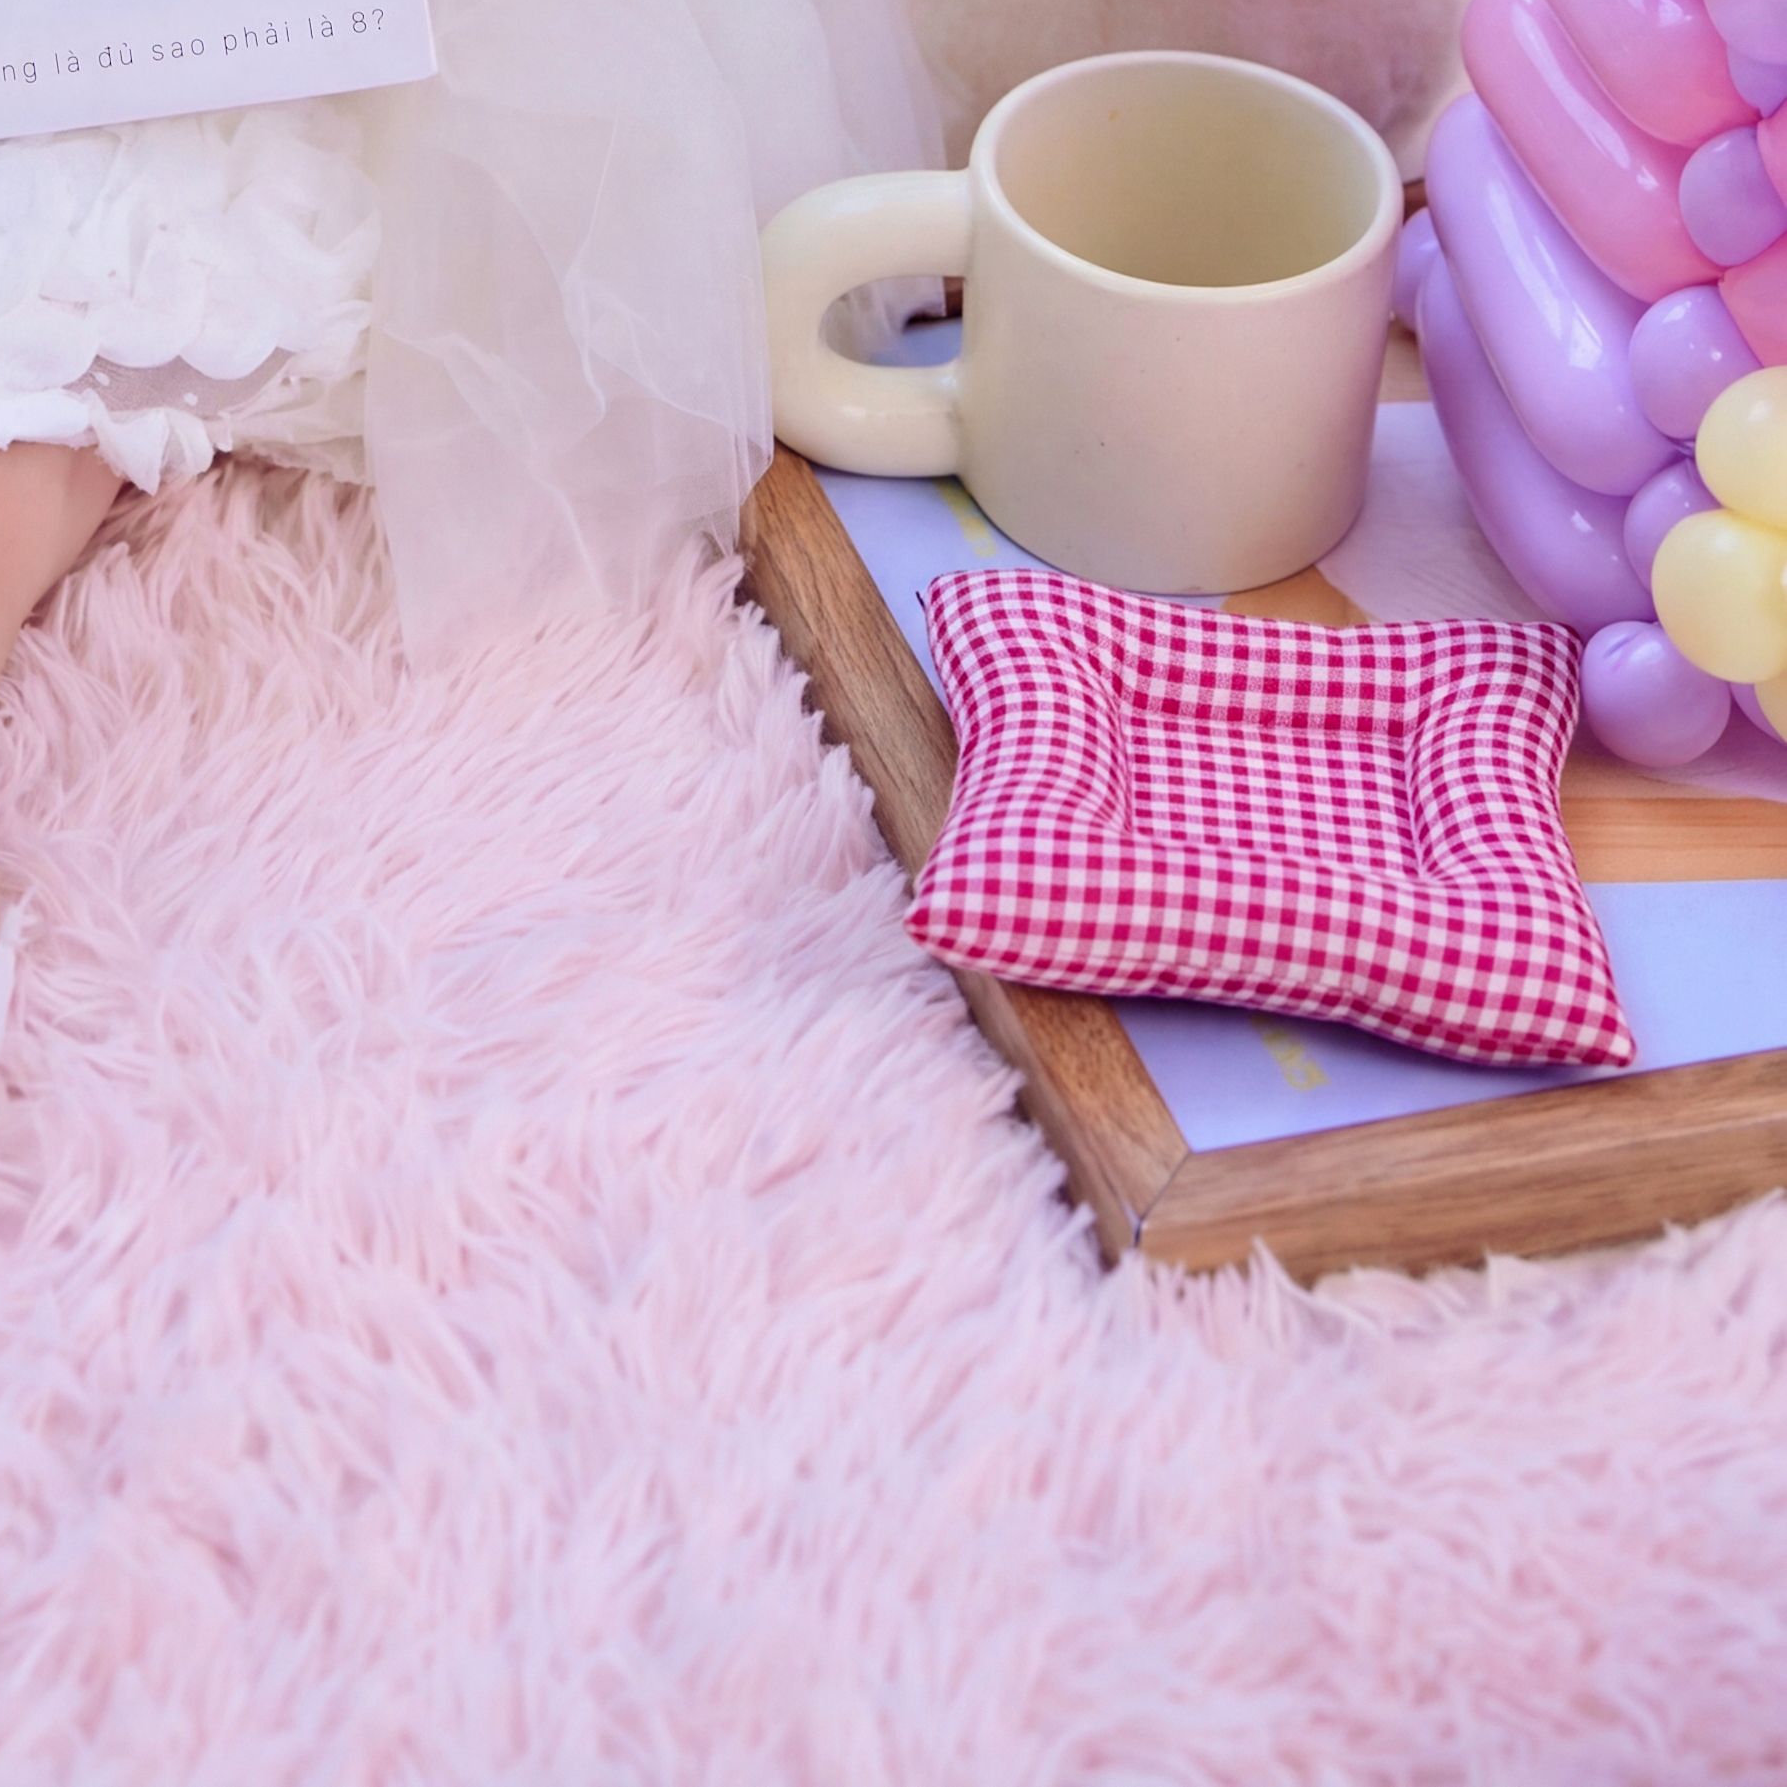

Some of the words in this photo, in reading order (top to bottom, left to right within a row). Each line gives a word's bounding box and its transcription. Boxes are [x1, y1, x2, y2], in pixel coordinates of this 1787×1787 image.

[53, 50, 82, 75] là
[97, 41, 135, 69] đủ
[150, 38, 206, 62] sao
[221, 21, 291, 56] phải
[307, 14, 335, 39] là
[350, 8, 386, 34] 8?
